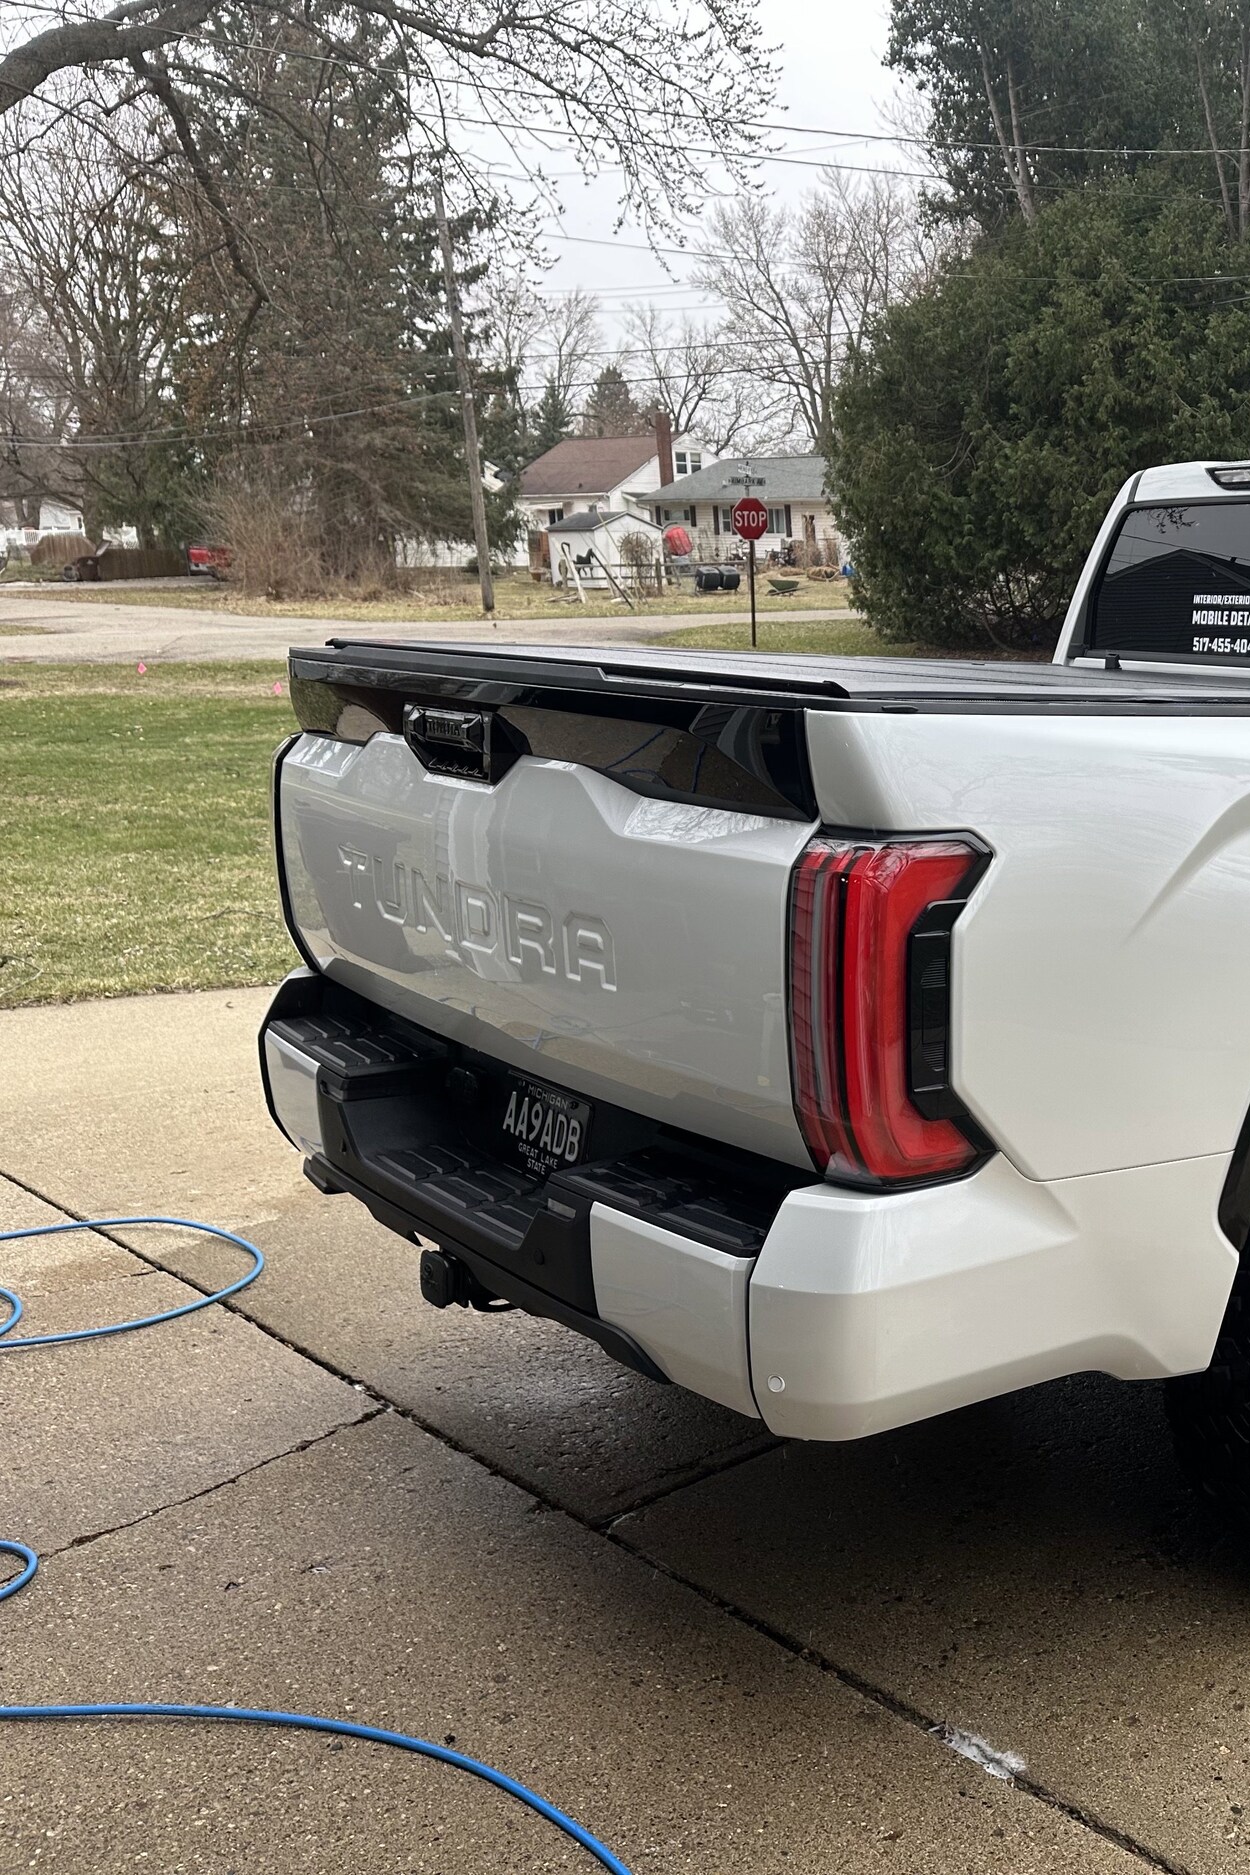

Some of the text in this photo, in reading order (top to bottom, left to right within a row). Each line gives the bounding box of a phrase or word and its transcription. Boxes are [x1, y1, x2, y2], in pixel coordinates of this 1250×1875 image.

[735, 511, 767, 527] STOP
[1192, 610, 1228, 625] MOBILE
[337, 843, 617, 991] TUNDRA
[528, 1085, 568, 1110] MICHIGAN
[503, 1091, 580, 1162] AA9ADB
[518, 1142, 558, 1169] GREAT LAKE
[527, 1158, 546, 1175] STATE
